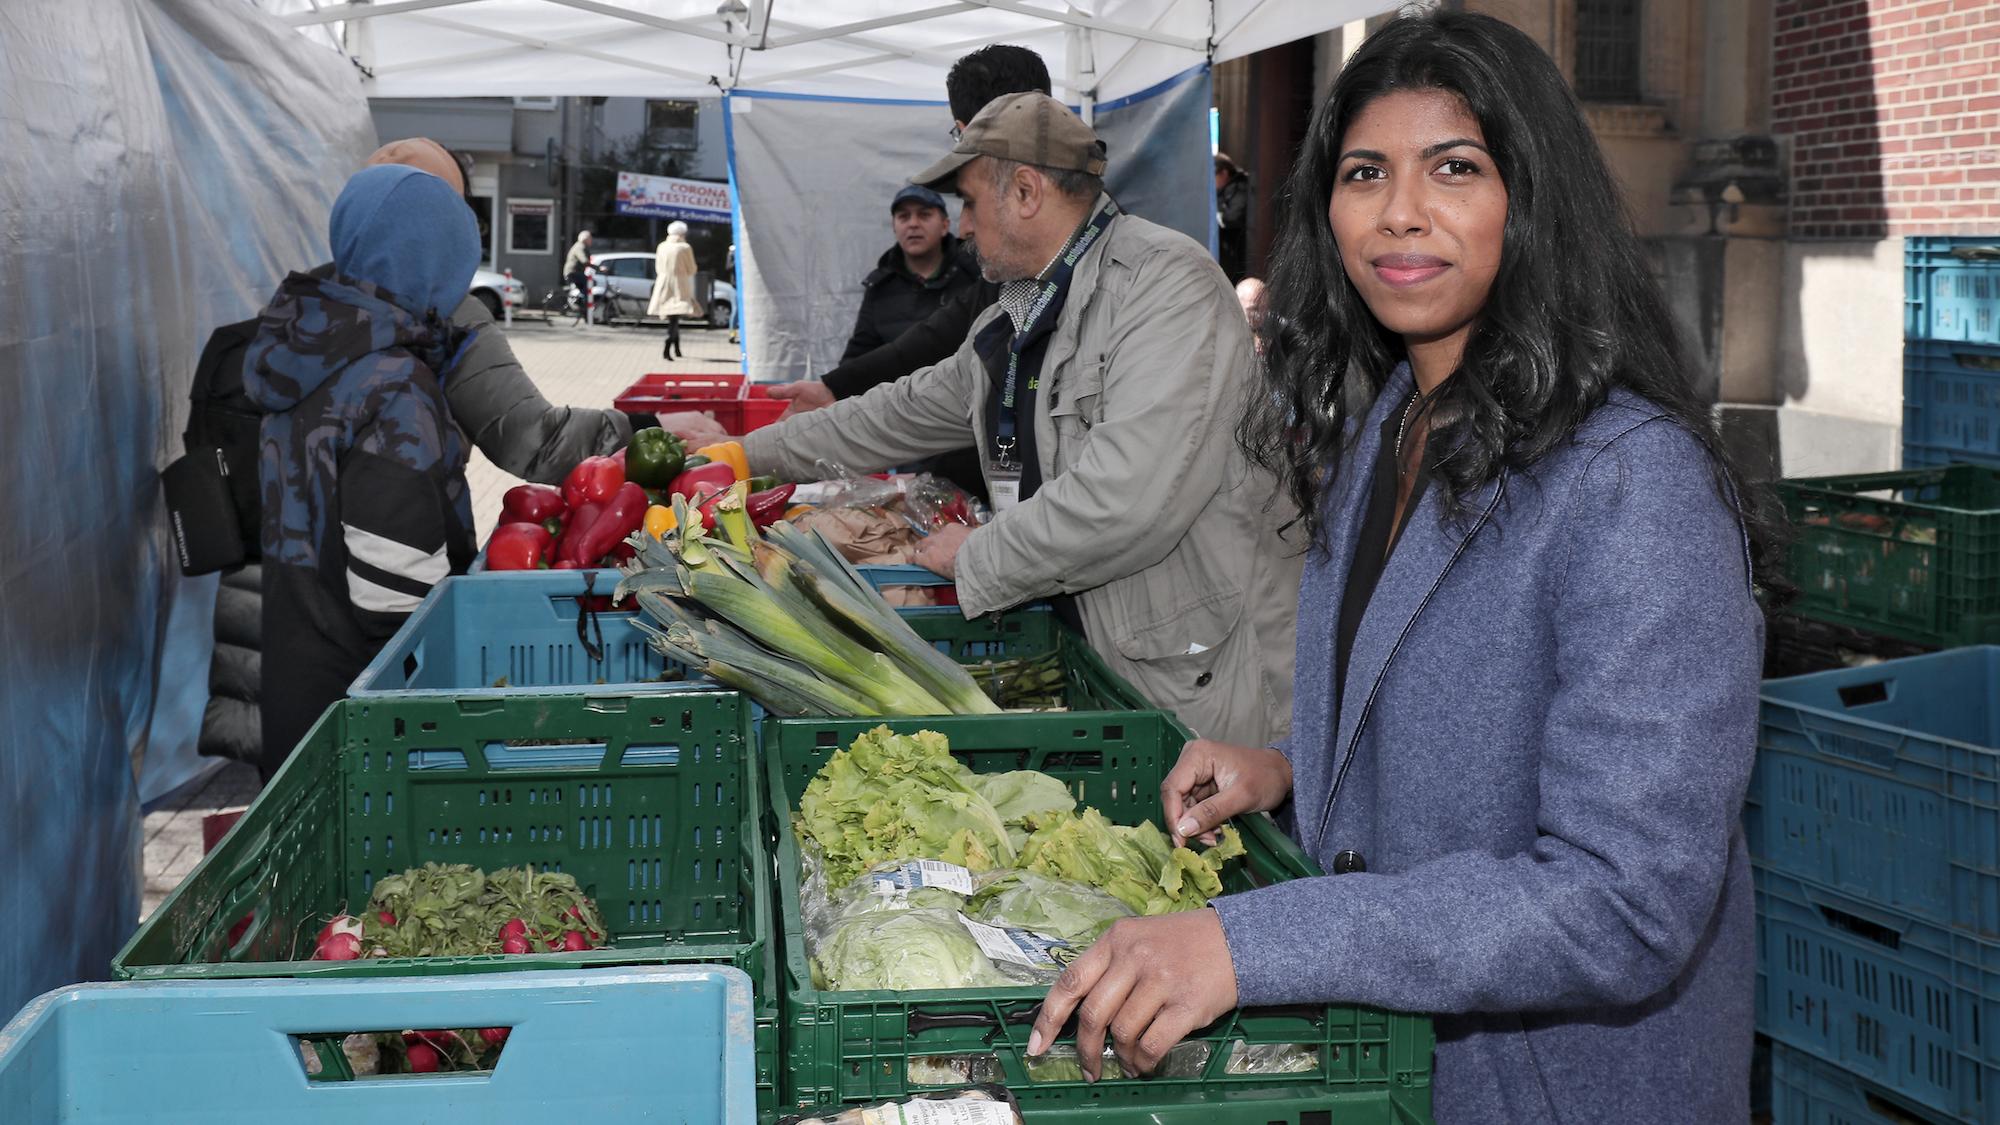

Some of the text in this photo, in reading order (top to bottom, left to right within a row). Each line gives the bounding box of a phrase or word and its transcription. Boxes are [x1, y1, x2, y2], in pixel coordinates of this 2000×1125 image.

[670, 183, 727, 198] CORONA
[658, 192, 732, 210] TESTCENTE
[621, 204, 678, 219] Kostenlose
